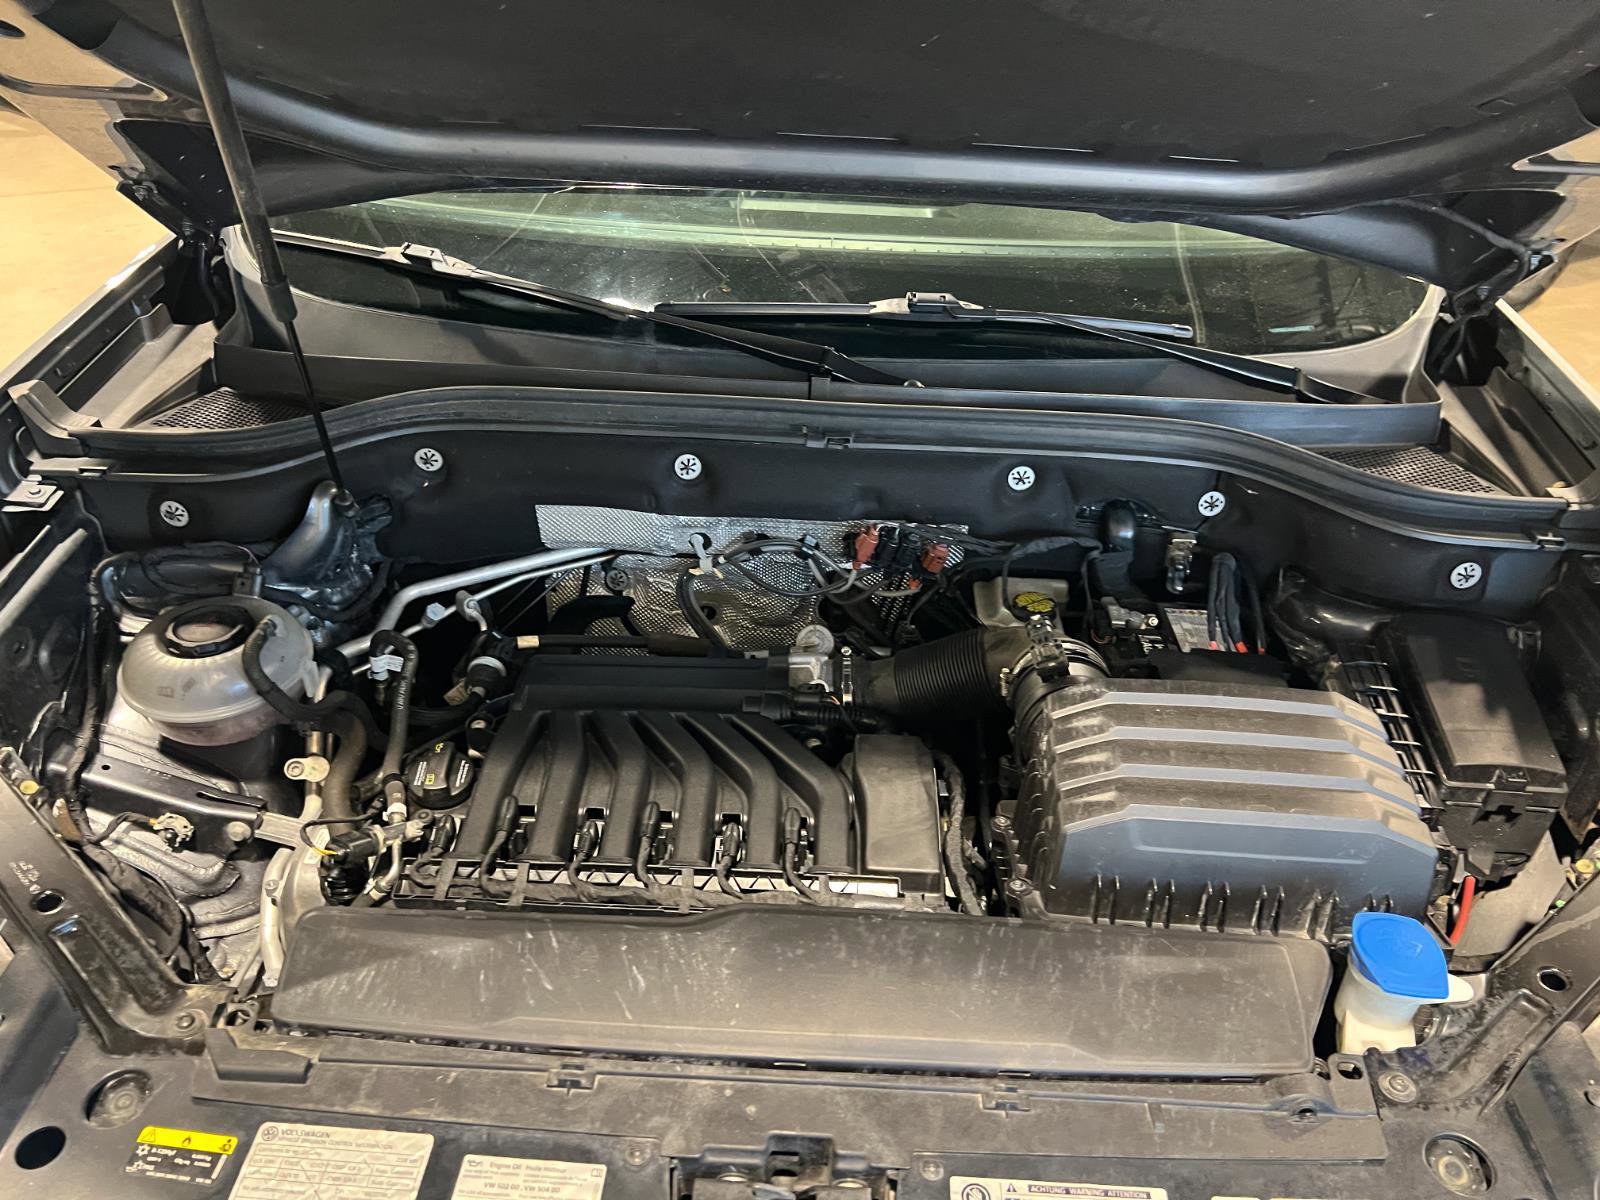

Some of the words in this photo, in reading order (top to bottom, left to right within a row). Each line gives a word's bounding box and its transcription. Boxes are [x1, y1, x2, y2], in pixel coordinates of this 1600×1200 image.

[1030, 1185, 1066, 1194] ACHTUNG
[1069, 1187, 1105, 1197] WARNING
[1107, 1189, 1148, 1199] ATTENTION
